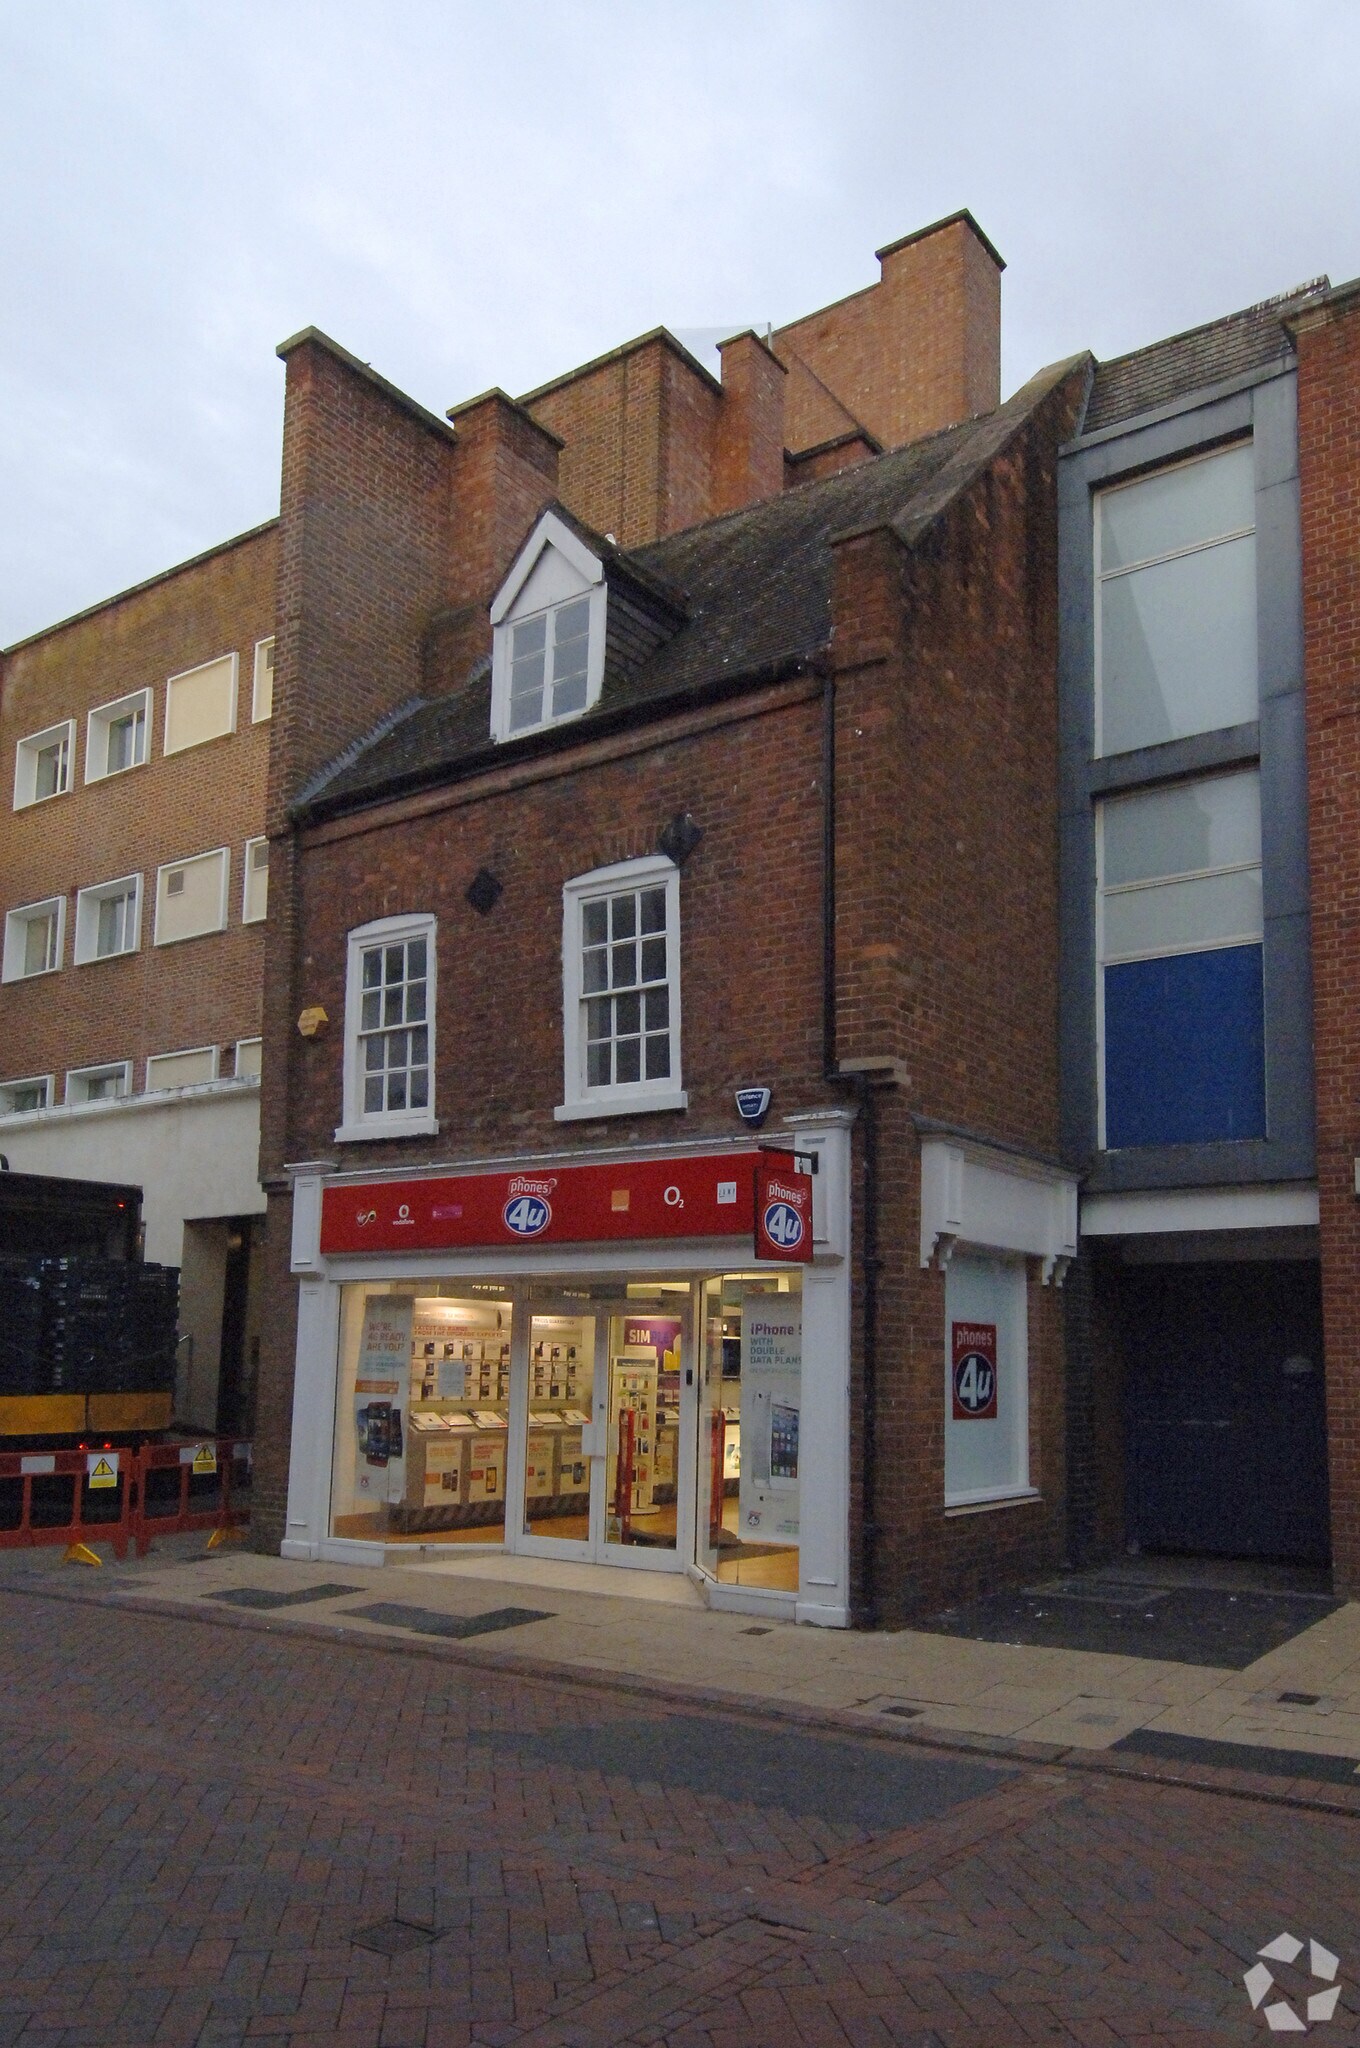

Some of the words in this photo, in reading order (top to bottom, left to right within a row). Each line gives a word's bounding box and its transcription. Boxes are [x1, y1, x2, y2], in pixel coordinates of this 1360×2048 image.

[510, 1179, 549, 1194] phones
[768, 1182, 802, 1204] phones
[508, 1199, 545, 1231] 4u
[768, 1206, 799, 1243] 4u
[750, 1322, 794, 1335] iPhone
[750, 1337, 773, 1345] WITH
[957, 1327, 992, 1348] phones
[366, 1342, 381, 1351] ARE
[384, 1342, 405, 1351] YOU?
[750, 1346, 785, 1355] DOUBLE
[750, 1356, 772, 1364] DATA
[959, 1357, 991, 1407] 4u
